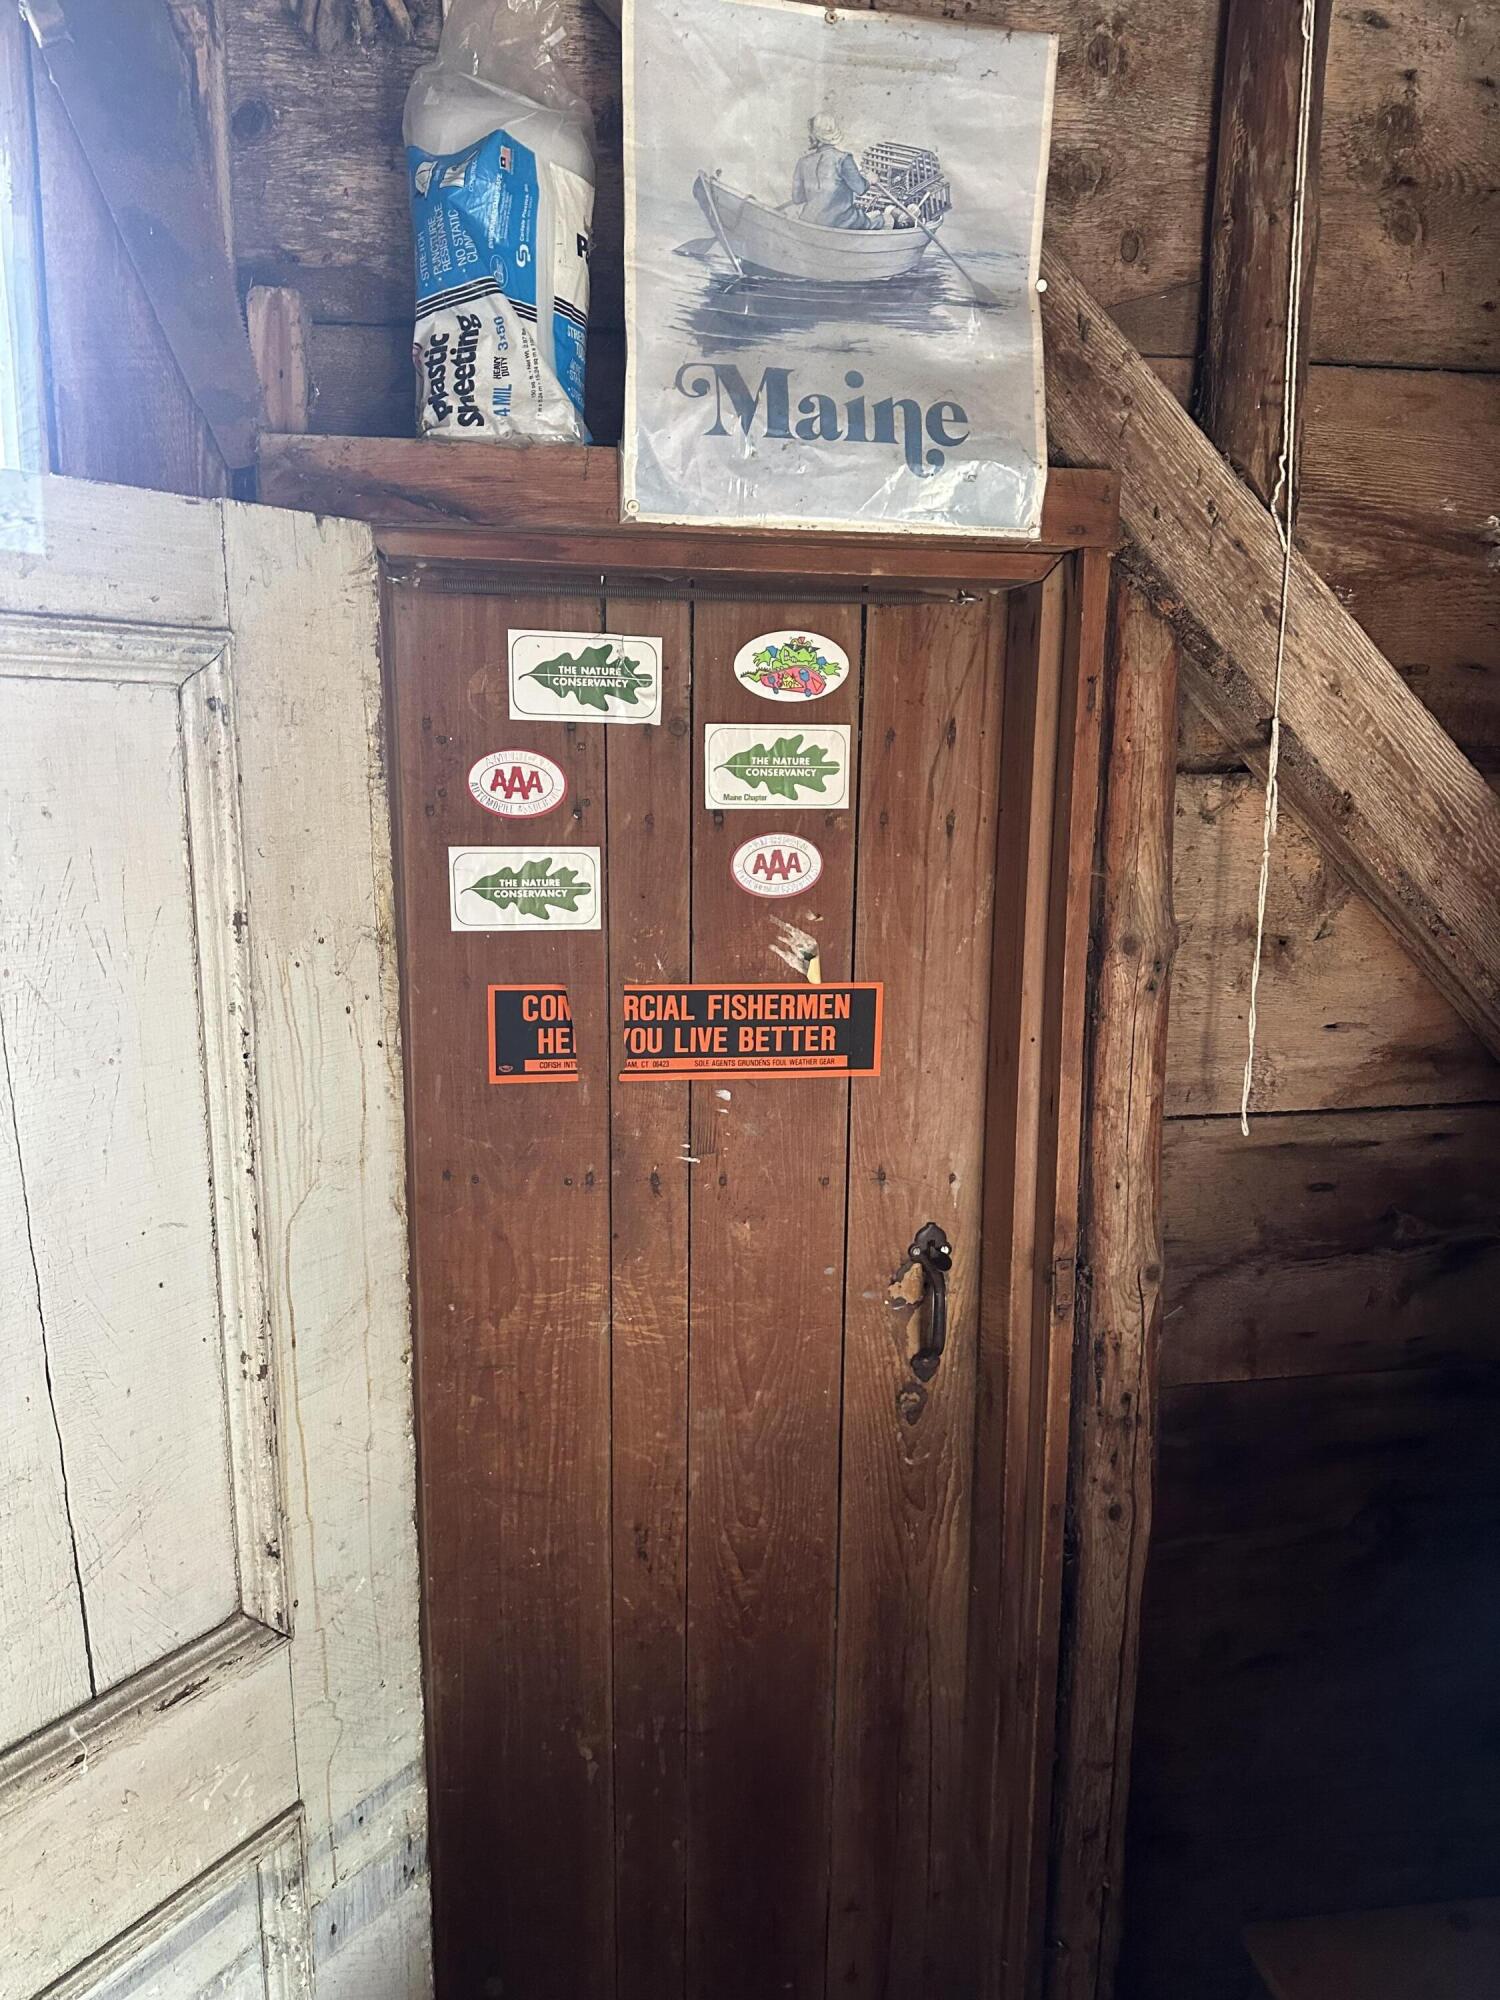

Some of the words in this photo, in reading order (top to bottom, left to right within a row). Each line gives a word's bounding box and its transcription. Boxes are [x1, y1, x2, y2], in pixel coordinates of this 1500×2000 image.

[434, 202, 453, 272] RESISTANCE
[447, 209, 463, 247] STATIC
[427, 216, 443, 276] PUNCTURE
[455, 249, 467, 267] NO
[492, 356, 502, 380] HEAVY
[501, 356, 510, 377] DUTY
[492, 384, 512, 406] MIL
[493, 408, 510, 416] 4
[675, 362, 971, 479] Maine
[558, 665, 577, 675] THE
[581, 666, 622, 676] NATURE
[552, 677, 629, 689] CONSERVANCY
[751, 756, 769, 766] THE
[772, 756, 811, 766] NATURE
[490, 766, 544, 800] AAA
[745, 768, 817, 777] CONSERVANCY
[723, 793, 743, 801] Maine
[743, 793, 767, 803] Chapter
[752, 848, 802, 881] AAA
[499, 878, 518, 887] THE
[521, 879, 561, 887] NATURE
[493, 889, 568, 898] CONSERVANCY
[707, 993, 851, 1021] FISHERMEN
[674, 1026, 728, 1053] LIVE
[738, 1024, 837, 1052] BETTER
[694, 1059, 710, 1067] SOLE
[712, 1059, 736, 1067] AGENTS
[789, 1058, 817, 1066] WEATHER
